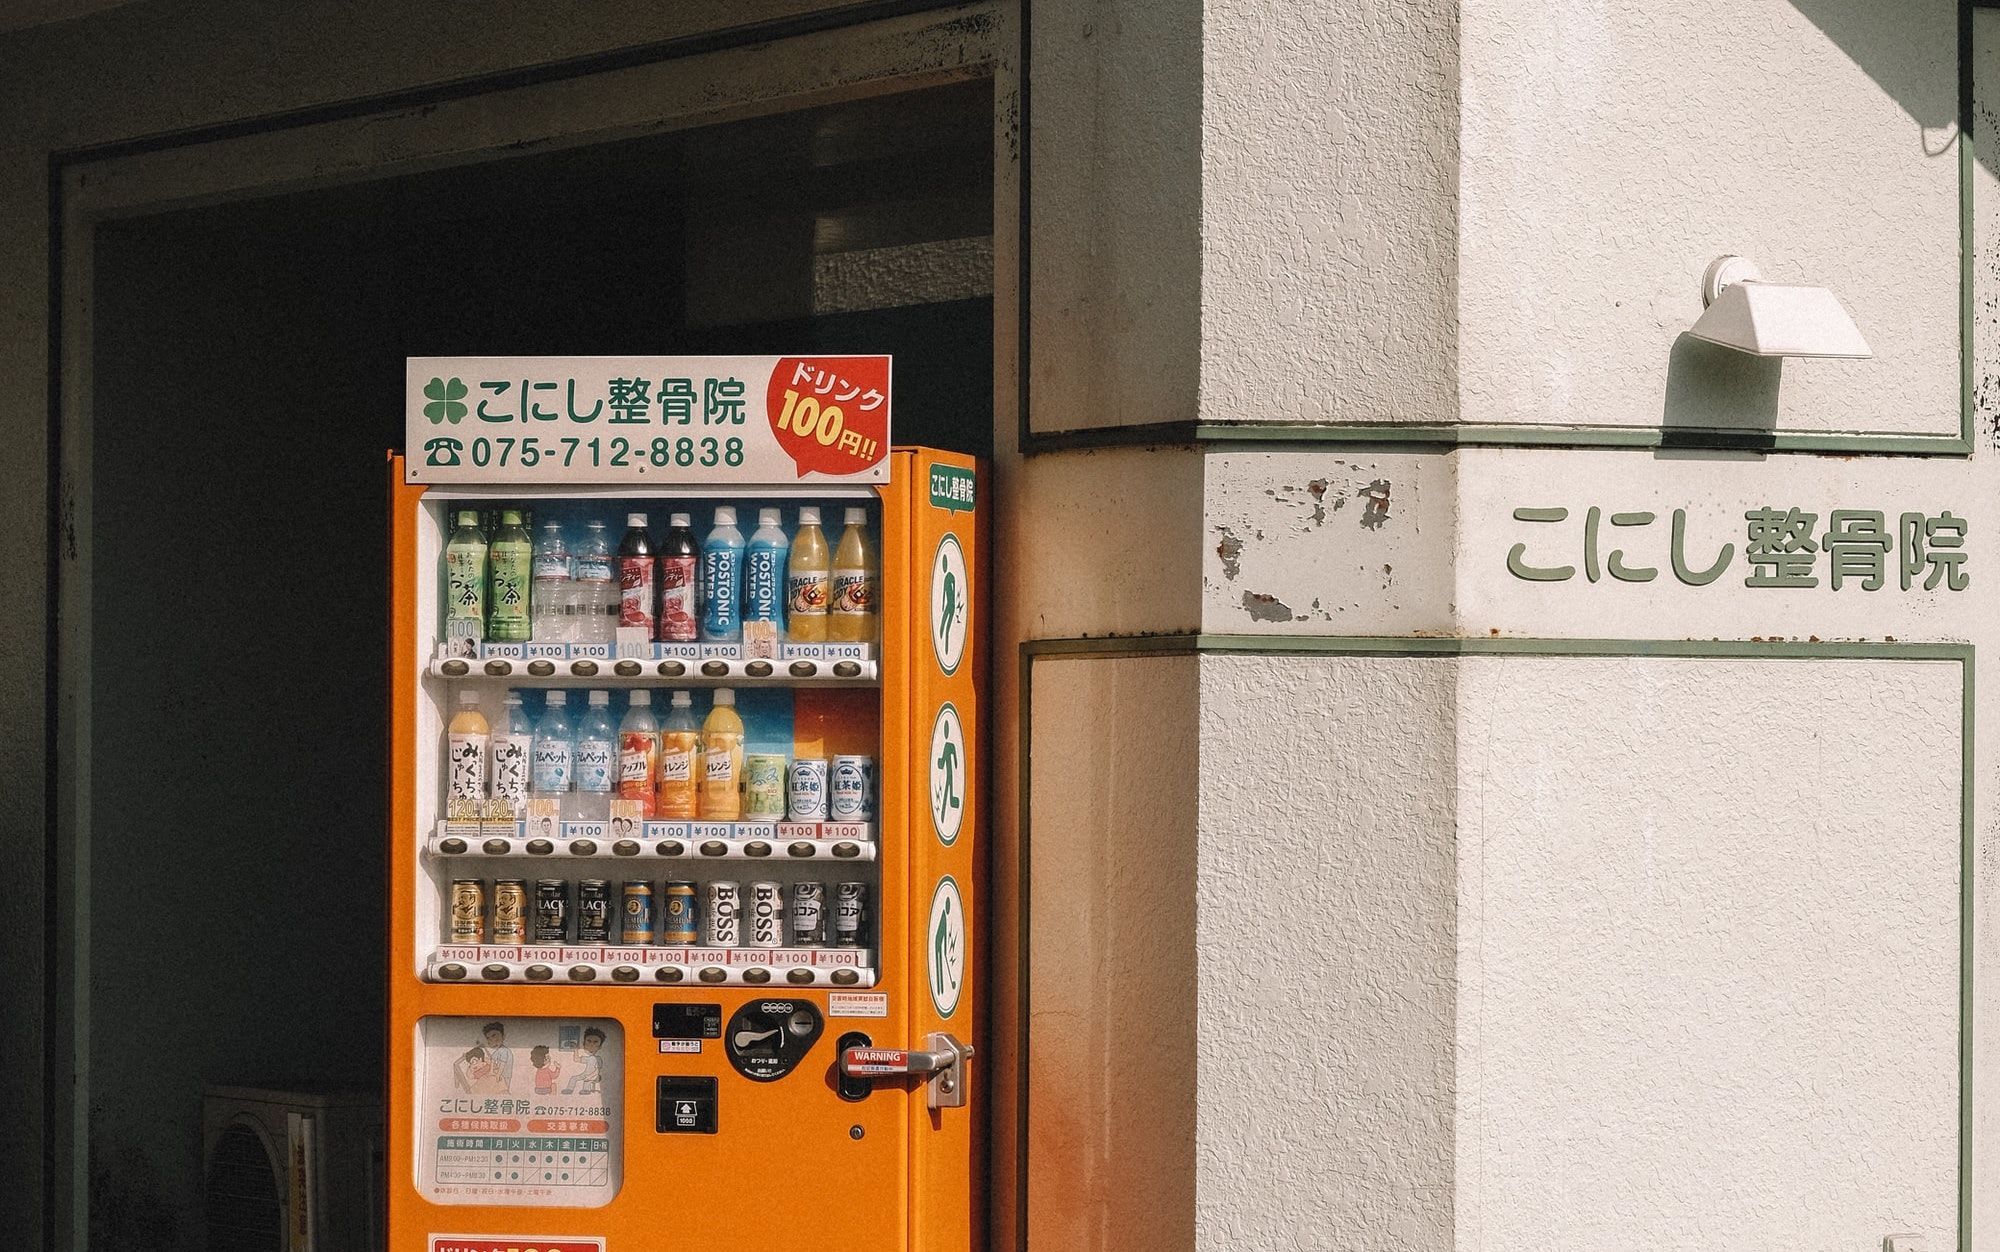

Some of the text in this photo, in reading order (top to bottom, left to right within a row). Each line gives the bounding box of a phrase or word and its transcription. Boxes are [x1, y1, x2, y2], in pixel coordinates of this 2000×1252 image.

[792, 361, 885, 411] ドリンク
[477, 377, 746, 426] こにし整骨院
[471, 437, 744, 468] 075-712-8838
[931, 474, 974, 503] こにし整骨院
[1507, 506, 1970, 592] こにし整骨院
[707, 552, 716, 599] WATER
[749, 552, 758, 599] WATER
[716, 551, 731, 625] POSTONIC
[487, 647, 519, 656] ¥100
[530, 647, 562, 656] ¥100
[573, 647, 605, 656] ¥100
[664, 647, 696, 656] ¥100
[704, 647, 737, 656] ¥100
[787, 647, 819, 656] ¥100
[828, 647, 860, 656] ¥100
[462, 742, 478, 799] みっくち
[621, 761, 646, 773] アップル
[570, 827, 601, 836] ¥100
[651, 827, 683, 836] ¥100
[695, 827, 726, 836] ¥100
[738, 827, 769, 836] ¥100
[781, 827, 812, 836] ¥100
[825, 827, 857, 836] ¥100
[538, 899, 565, 910] LACK
[581, 900, 607, 911] LACK
[717, 887, 734, 941] BOSS
[756, 887, 773, 942] BOSS
[442, 951, 473, 959] ¥100
[483, 951, 514, 959] ¥100
[524, 951, 556, 960] ¥100
[566, 952, 597, 960] ¥100
[608, 952, 639, 961] ¥100
[650, 953, 681, 962] ¥100
[690, 953, 723, 962] ¥100
[734, 954, 766, 963] ¥100
[775, 954, 808, 963] ¥100
[819, 955, 851, 964] ¥100
[854, 1051, 901, 1062] WARNING
[440, 1098, 530, 1115] こにし整骨院
[495, 1139, 503, 1148] 月
[512, 1140, 520, 1148] 火
[528, 1140, 537, 1149] 水
[545, 1140, 554, 1149] 木
[562, 1140, 571, 1149] 金
[579, 1141, 587, 1149] 土
